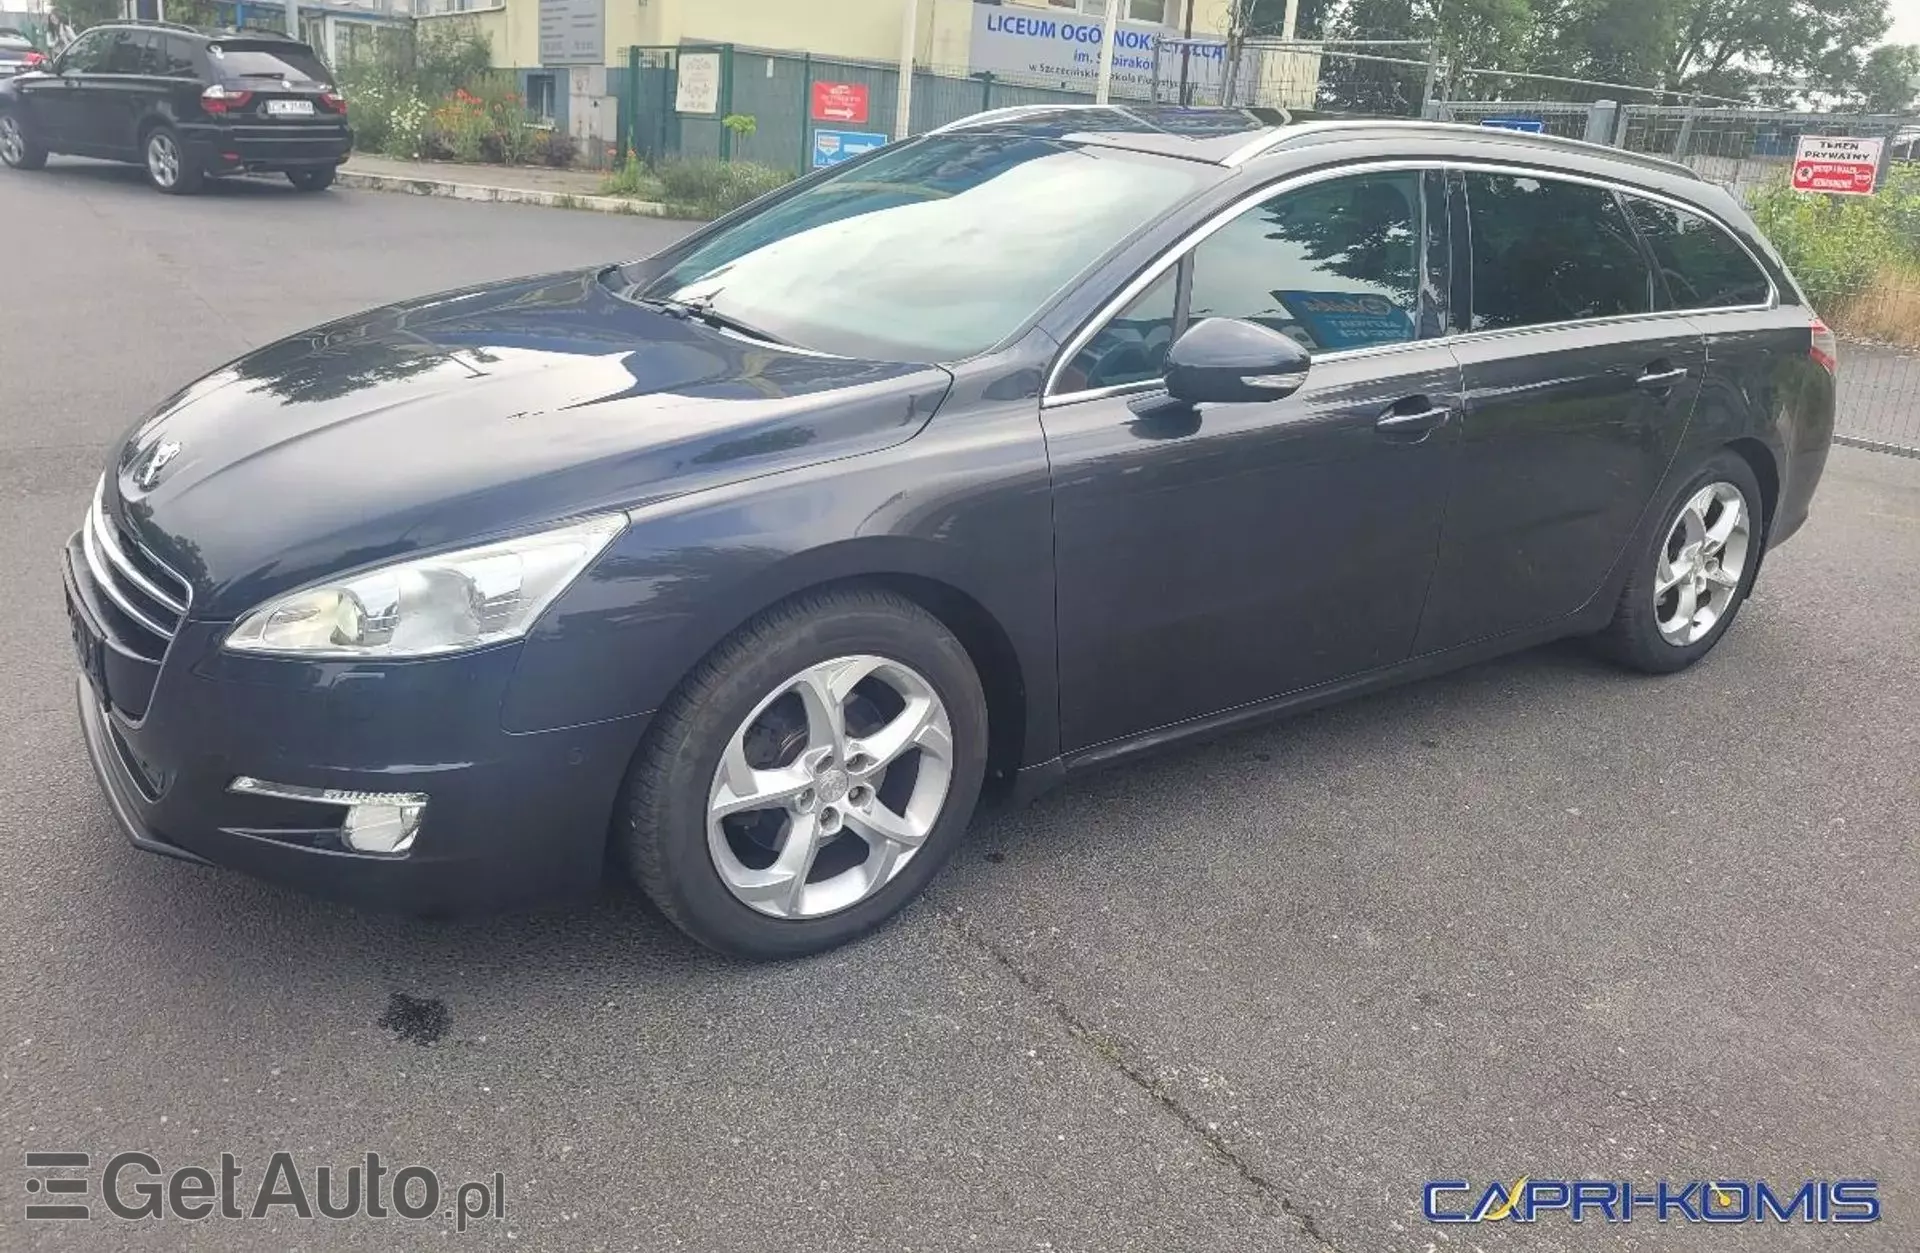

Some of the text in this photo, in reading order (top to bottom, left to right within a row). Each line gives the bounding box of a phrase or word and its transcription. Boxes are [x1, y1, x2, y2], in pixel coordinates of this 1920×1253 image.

[987, 12, 1056, 39] LICEUM
[1074, 49, 1093, 64] im.
[1804, 150, 1870, 160] PRYWATNY
